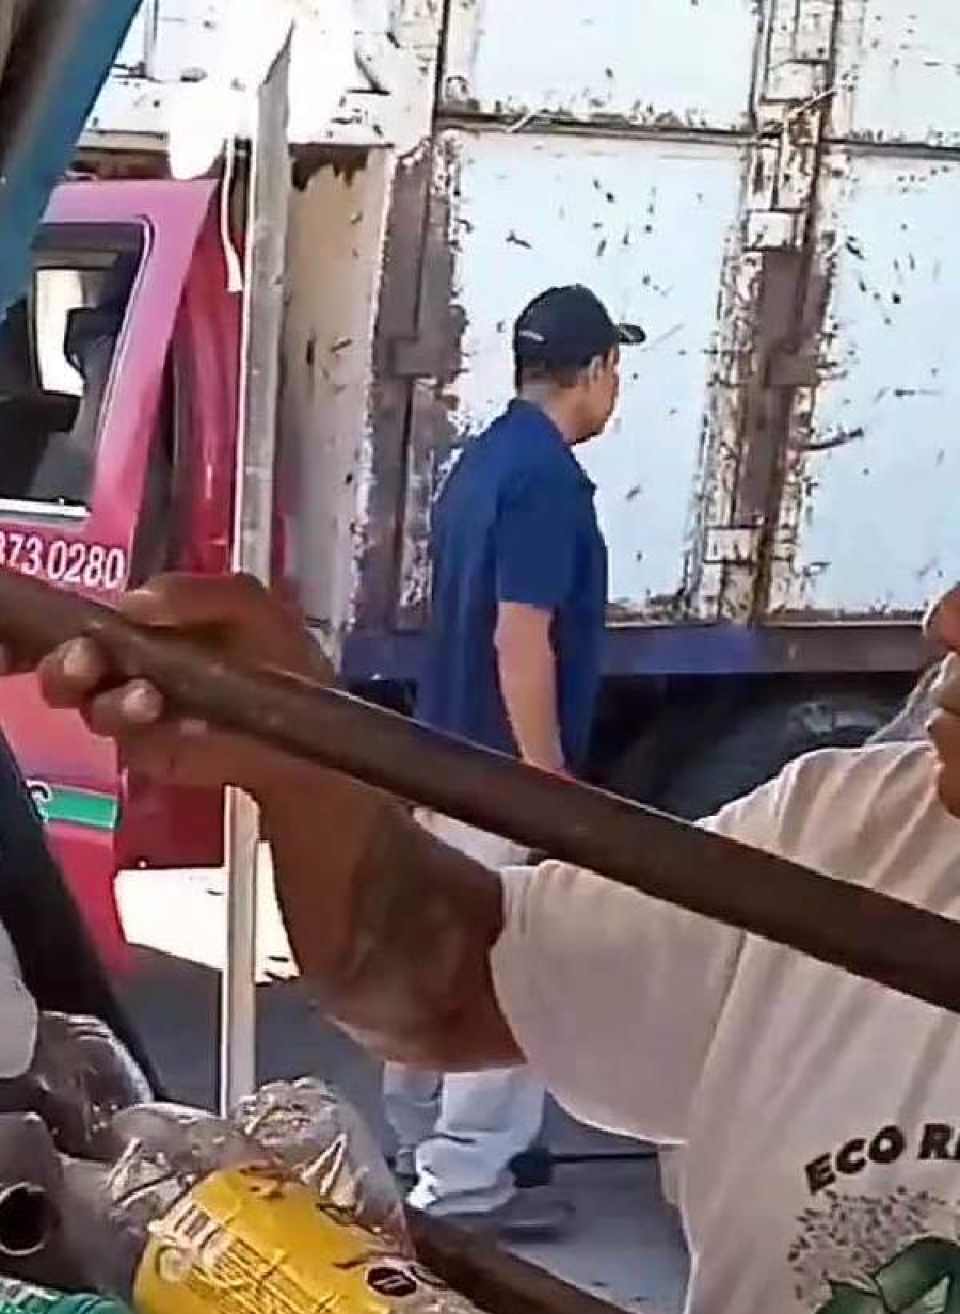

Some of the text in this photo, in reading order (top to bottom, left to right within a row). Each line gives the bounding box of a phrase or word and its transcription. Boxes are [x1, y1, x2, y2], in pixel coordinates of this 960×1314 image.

[46, 539, 126, 590] 0280
[805, 1122, 960, 1196] ECO R
